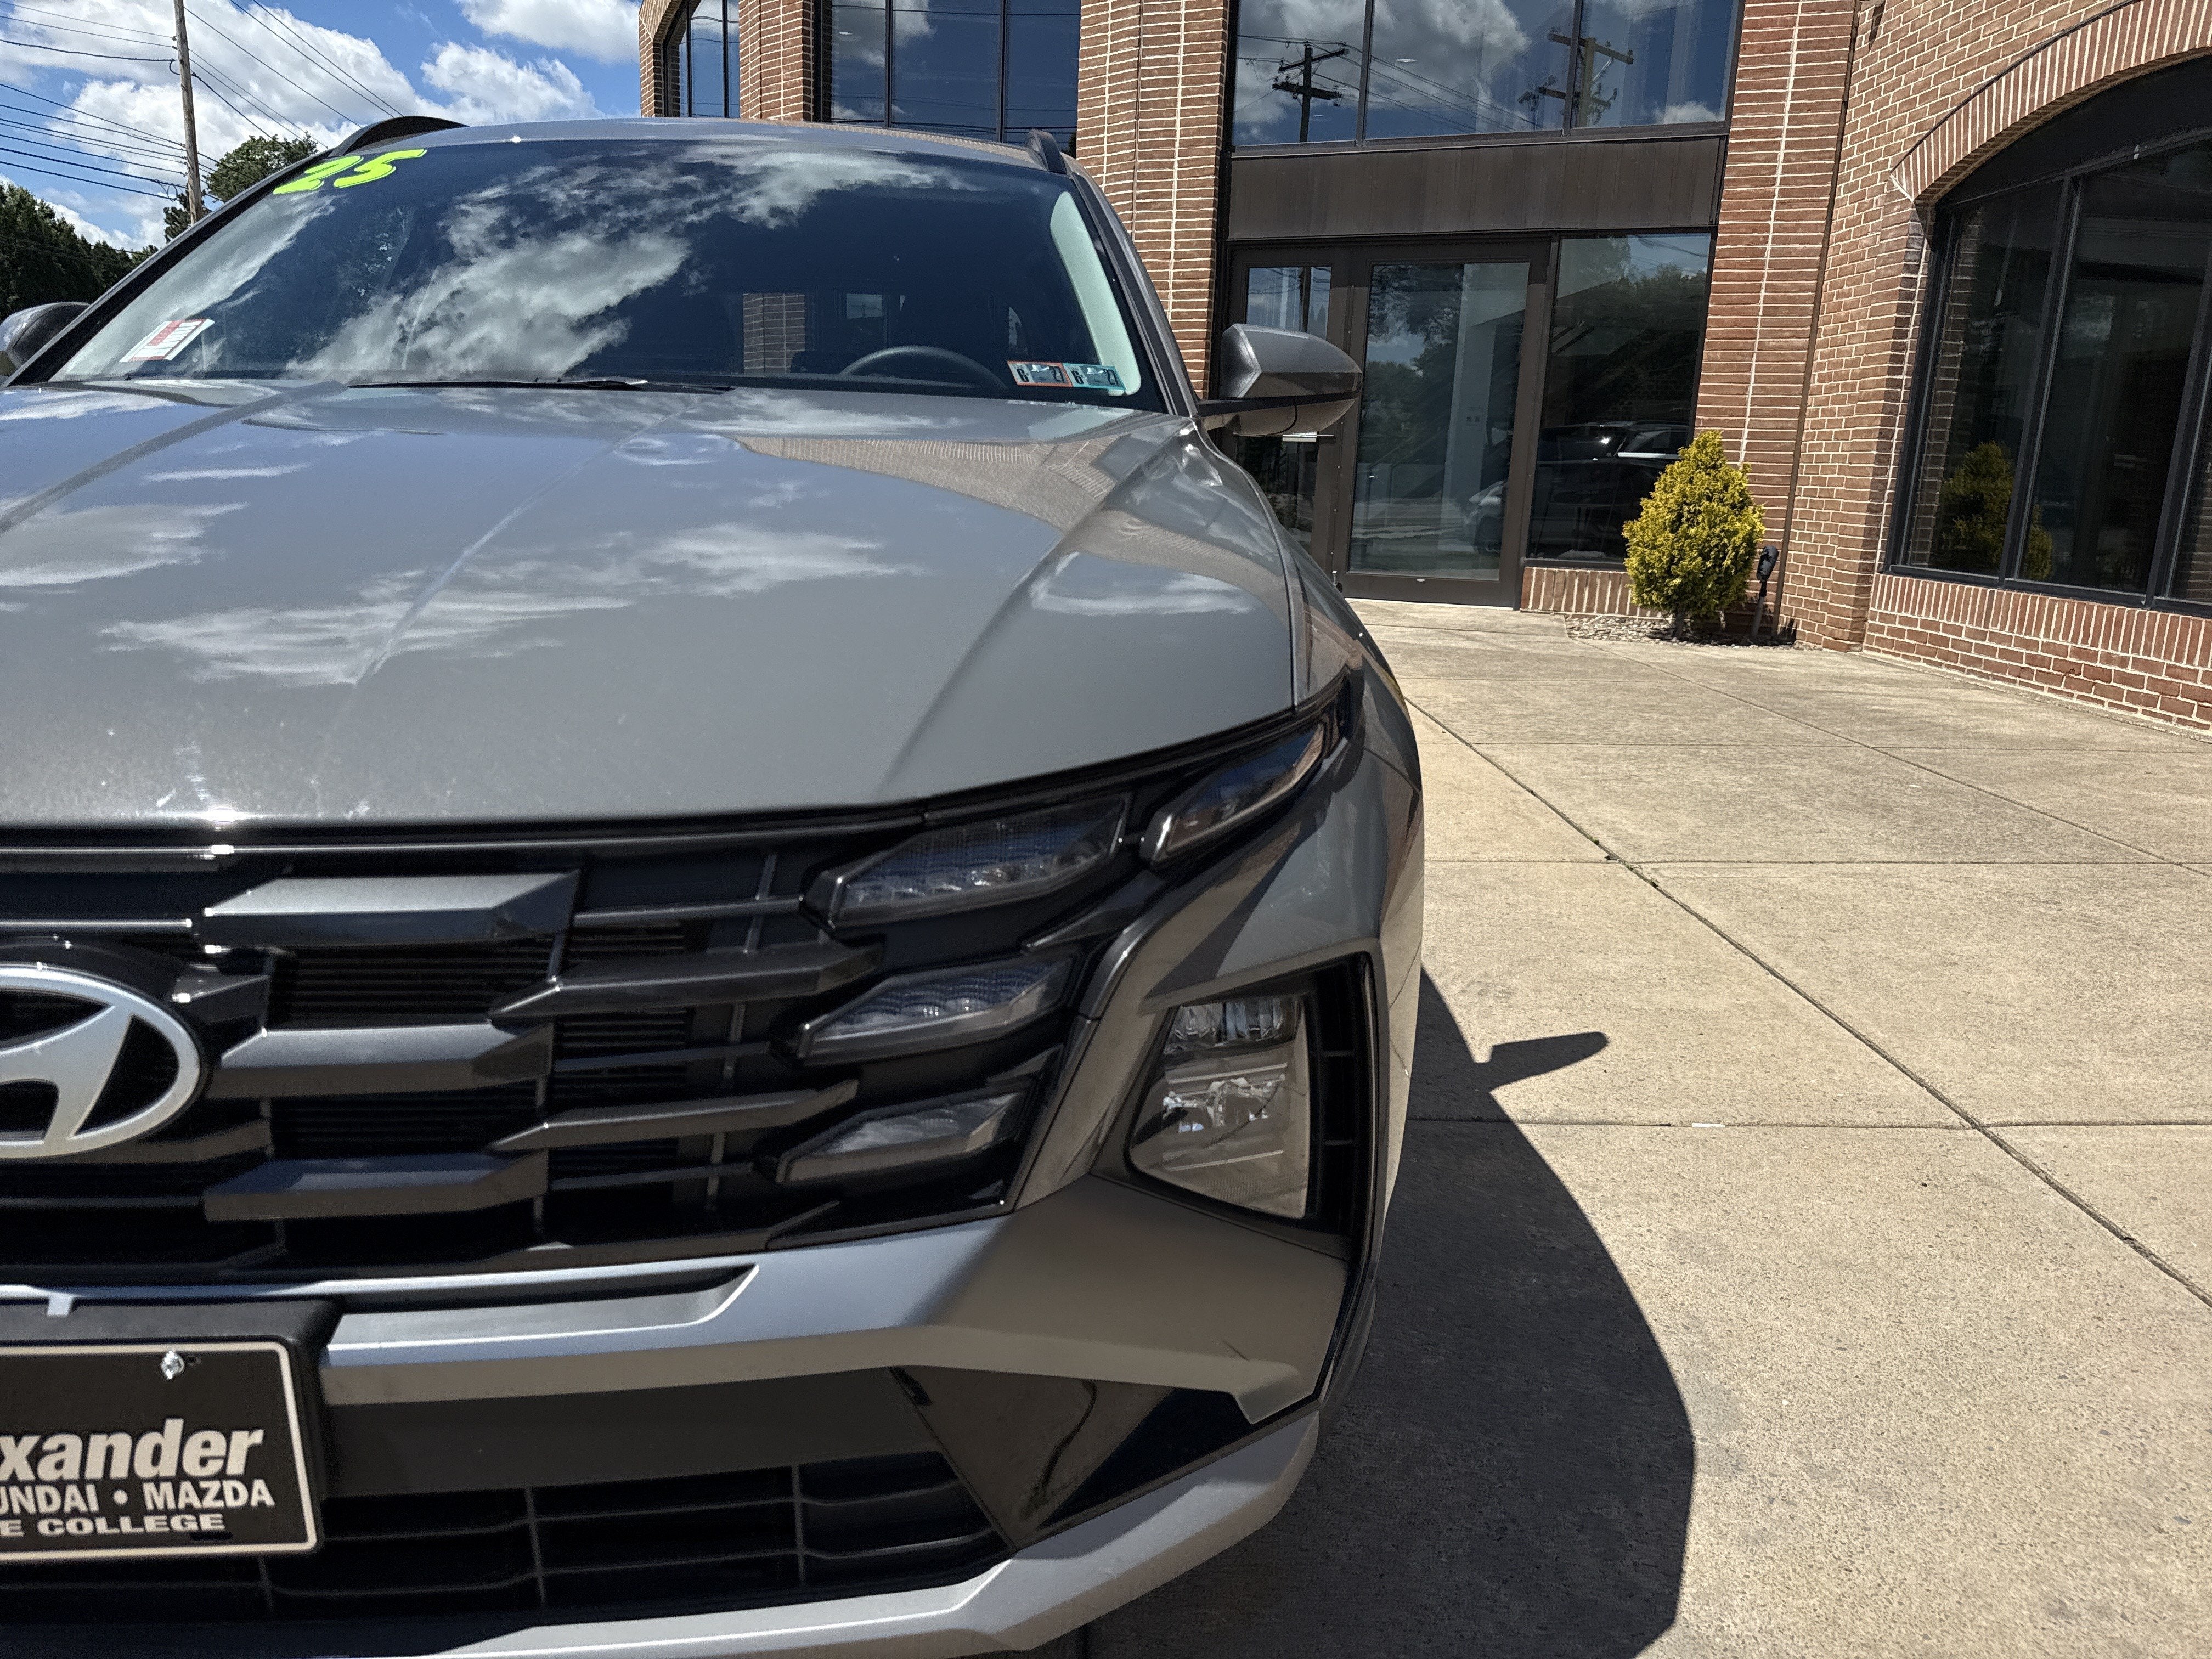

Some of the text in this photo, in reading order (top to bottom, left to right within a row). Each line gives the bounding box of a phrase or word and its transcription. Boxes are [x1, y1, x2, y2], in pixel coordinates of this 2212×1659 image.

[273, 149, 427, 194] 25
[1017, 368, 1029, 382] 6
[1071, 370, 1084, 384] 6
[0, 1418, 264, 1480] xander
[143, 1479, 275, 1510] MAZDA
[37, 1513, 225, 1536] COLLEGE
